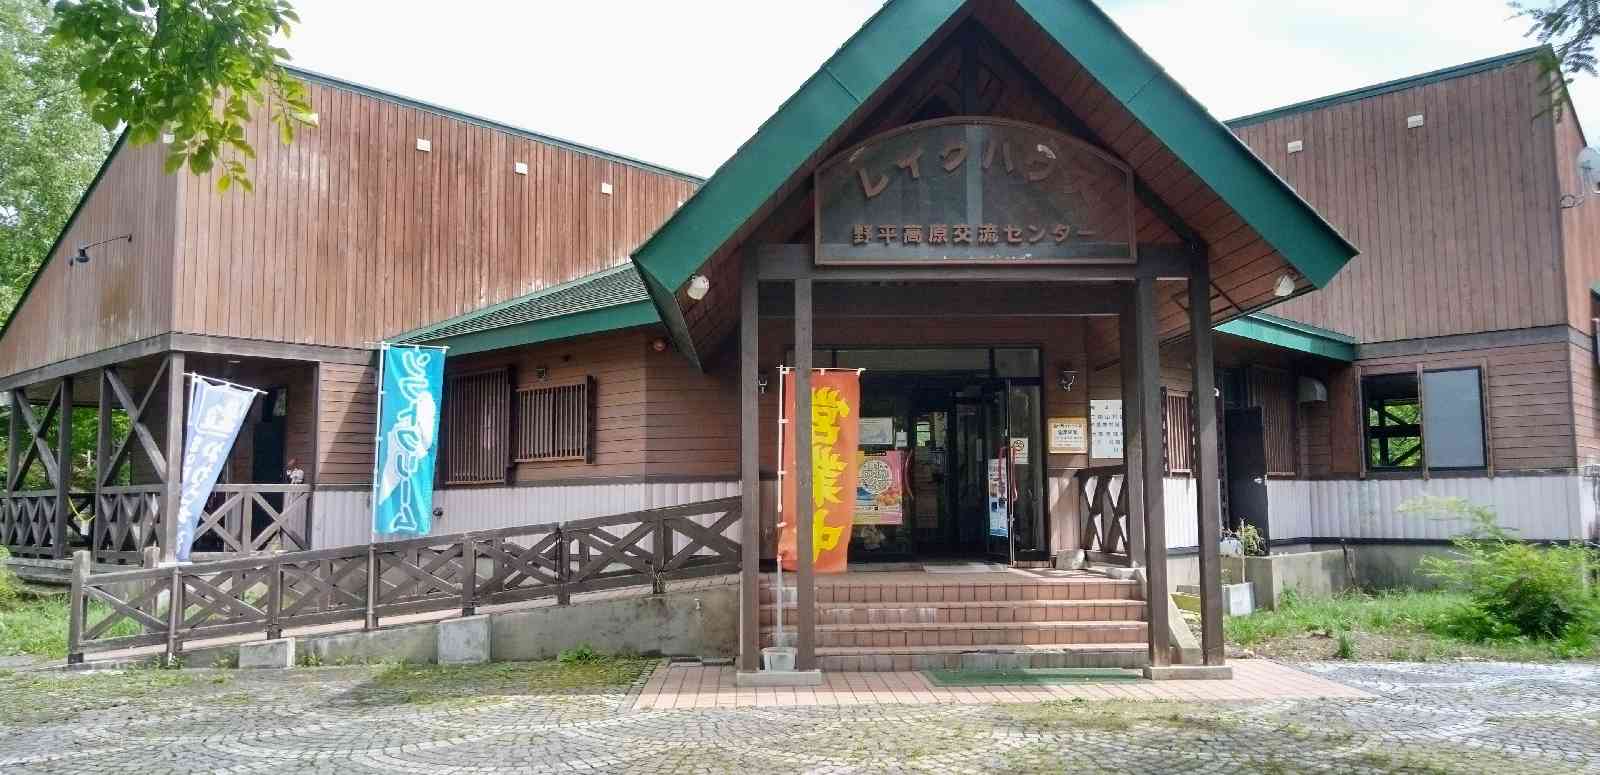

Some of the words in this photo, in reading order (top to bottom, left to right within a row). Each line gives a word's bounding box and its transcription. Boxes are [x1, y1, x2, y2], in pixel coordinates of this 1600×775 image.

[853, 223, 1097, 244] 野平高原交流センター
